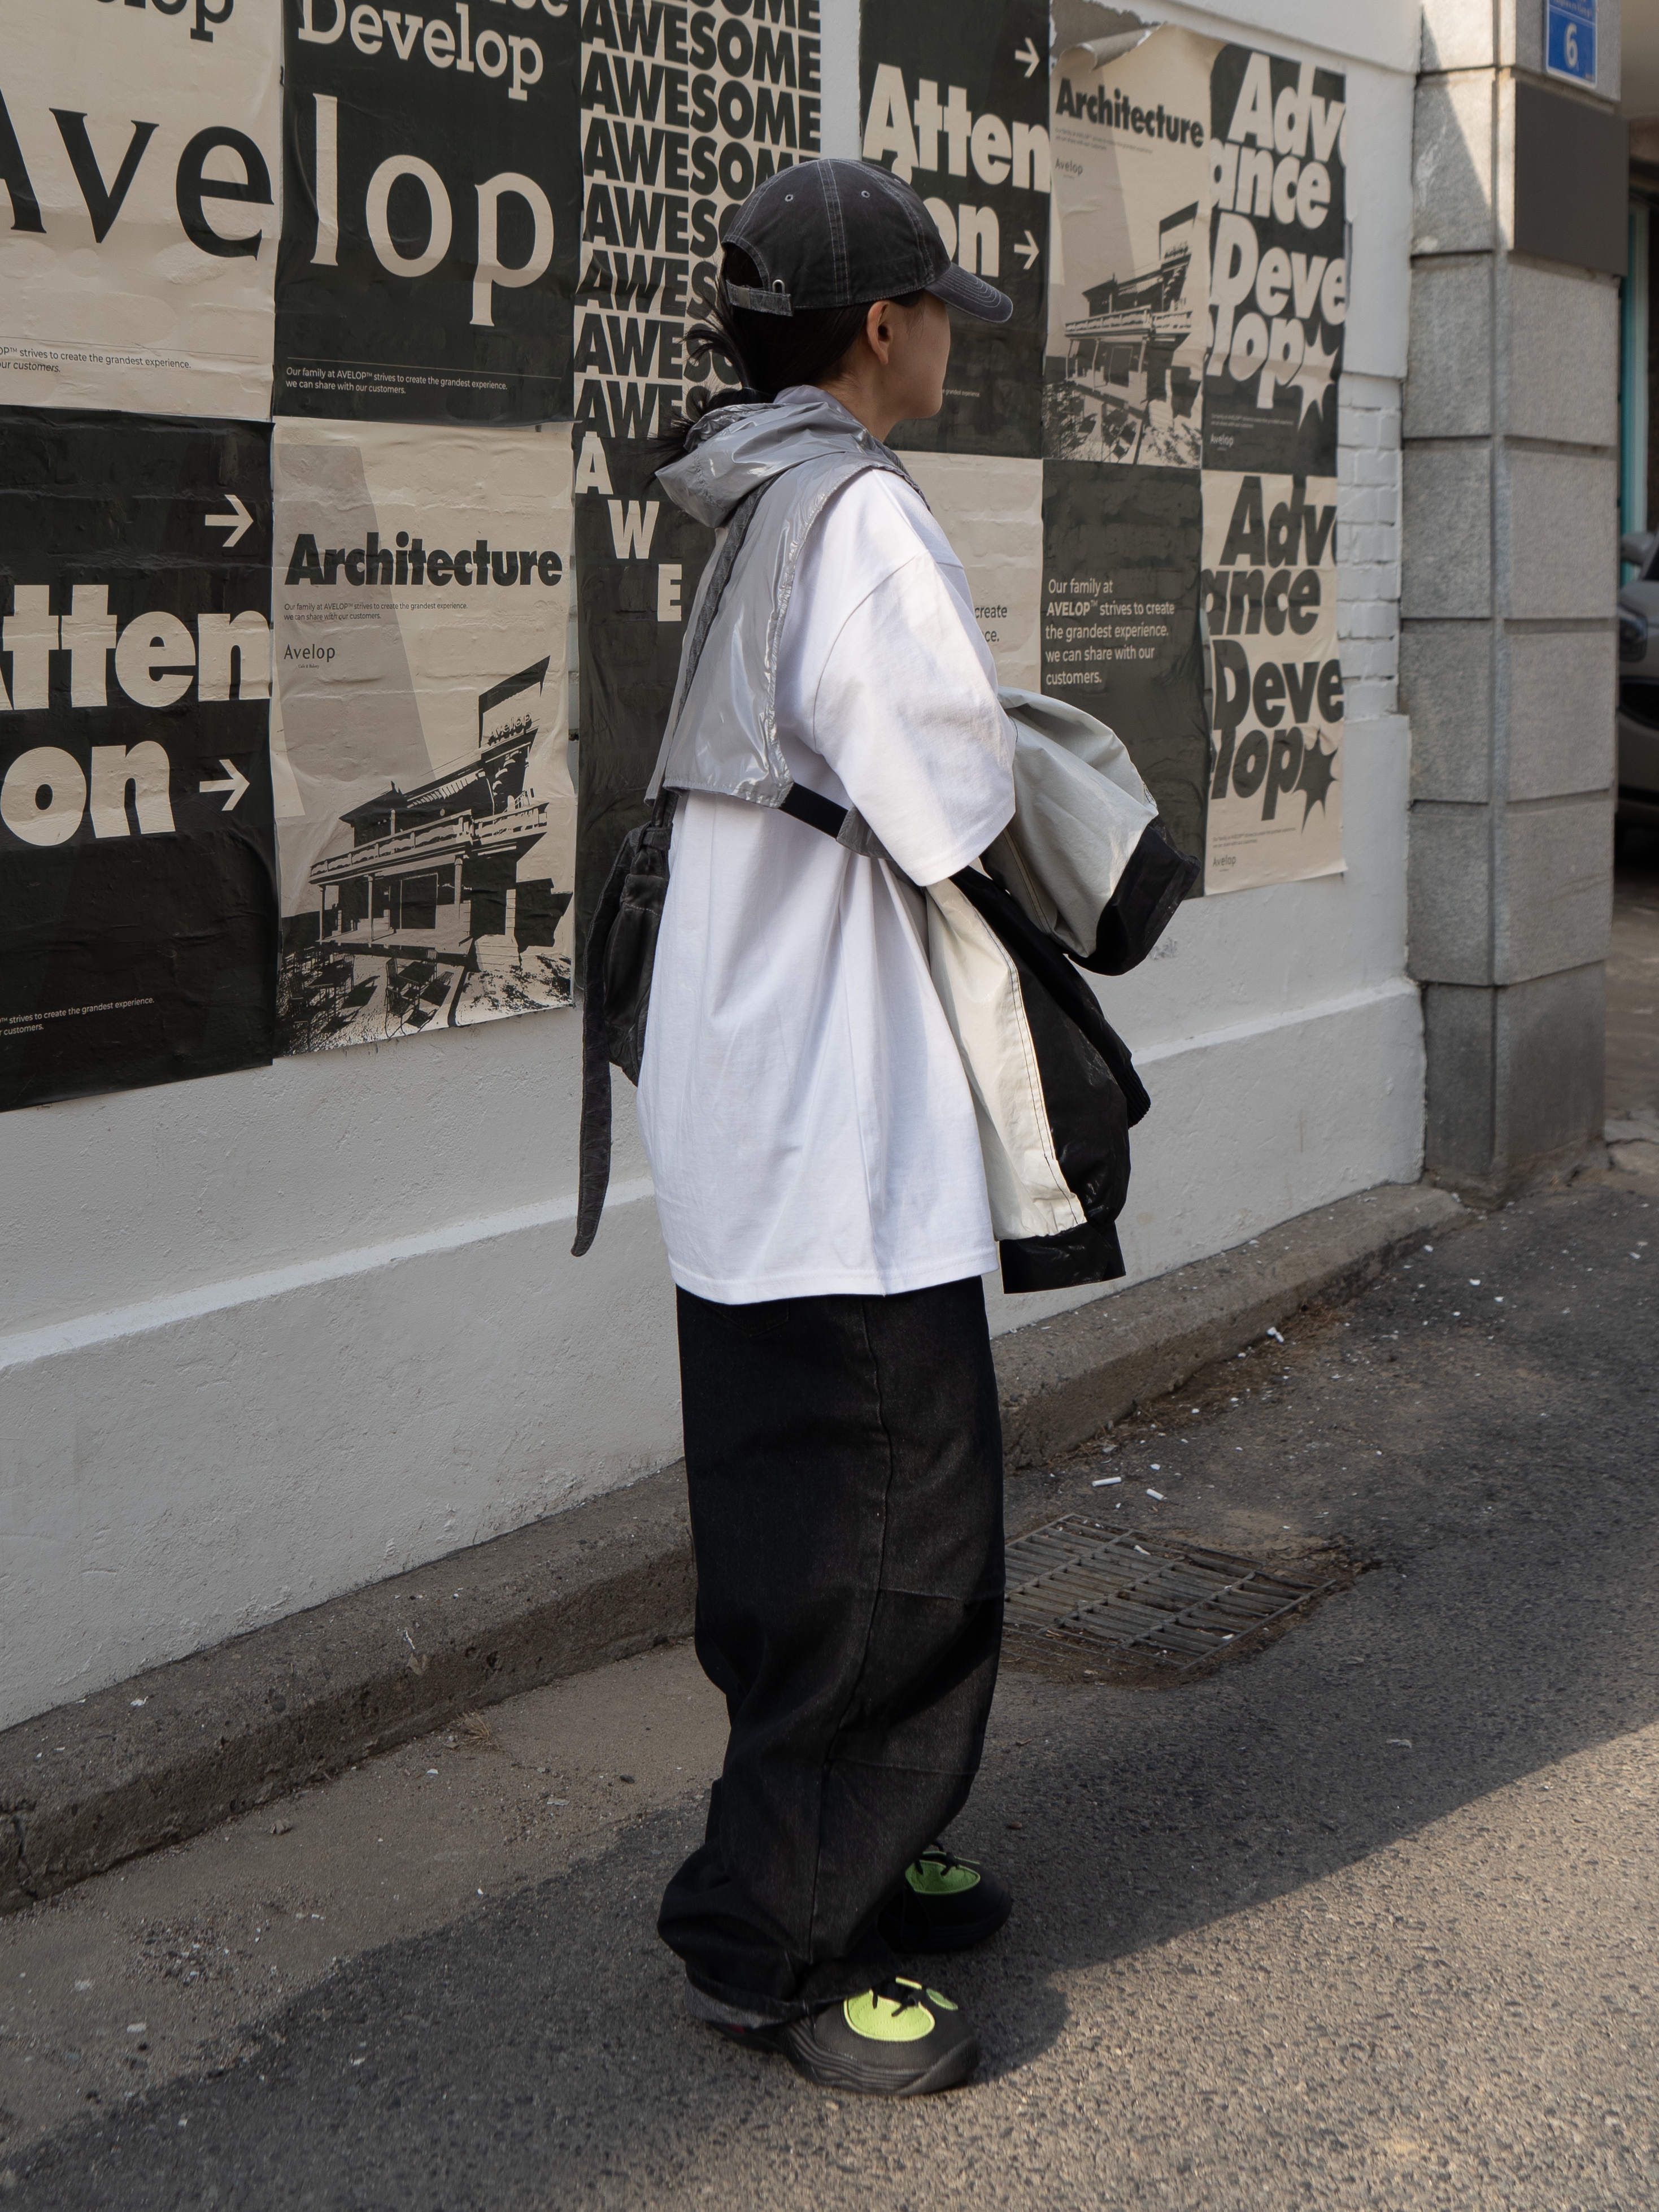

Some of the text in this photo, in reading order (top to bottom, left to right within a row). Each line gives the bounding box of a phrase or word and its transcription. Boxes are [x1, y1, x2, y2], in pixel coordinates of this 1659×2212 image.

[298, 0, 543, 101] Develop
[581, 0, 821, 93] AWESOME
[1564, 22, 1578, 67] 6
[581, 50, 821, 153] AWESOME
[1055, 78, 1204, 148] Architecture
[1226, 51, 1347, 168] Adv
[862, 63, 1051, 193] Atten
[583, 117, 818, 201] AWESO
[1055, 158, 1083, 176] Avelop
[1210, 137, 1331, 229] ance
[582, 183, 741, 258] AWES
[573, 249, 719, 320] AWES
[1210, 212, 1346, 326] Deve
[13, 360, 61, 373] customers.
[19, 348, 48, 359] strives
[49, 351, 59, 360] to
[60, 351, 87, 362] create
[89, 354, 103, 363] the
[106, 356, 143, 366] grandest
[145, 358, 191, 369] experience.
[573, 312, 742, 385] AWES
[286, 367, 301, 376] Our
[302, 367, 326, 379] family
[374, 373, 396, 382] strives
[406, 376, 426, 384] create
[428, 376, 439, 385] the
[440, 379, 471, 388] grandest
[472, 380, 508, 390] experience.
[315, 381, 336, 390] share
[337, 382, 355, 391] with
[1210, 433, 1234, 447] Avelop
[1219, 475, 1337, 568] Adv
[284, 531, 563, 586] Architecture
[297, 603, 315, 612] family
[411, 602, 436, 611] grandest
[437, 602, 468, 610] experience.
[974, 605, 1008, 619] create
[1048, 578, 1113, 597] Our family at
[1100, 600, 1132, 616] strives
[1134, 601, 1144, 615] to
[1146, 601, 1175, 615] create
[1201, 568, 1321, 636] ance
[0, 585, 273, 710] tten
[284, 644, 336, 663] Avelop
[1046, 622, 1169, 643] the grandest experience.
[1046, 644, 1155, 663] we can share with our
[1046, 671, 1102, 685] customers.
[1212, 640, 1344, 730] Deve
[1, 741, 175, 846] on
[1213, 855, 1236, 867] Avelop
[3, 1023, 44, 1036] customers.
[9, 1014, 33, 1024] strives
[43, 1010, 67, 1019] create
[82, 1002, 114, 1015] grandest
[115, 997, 155, 1009] experience.
